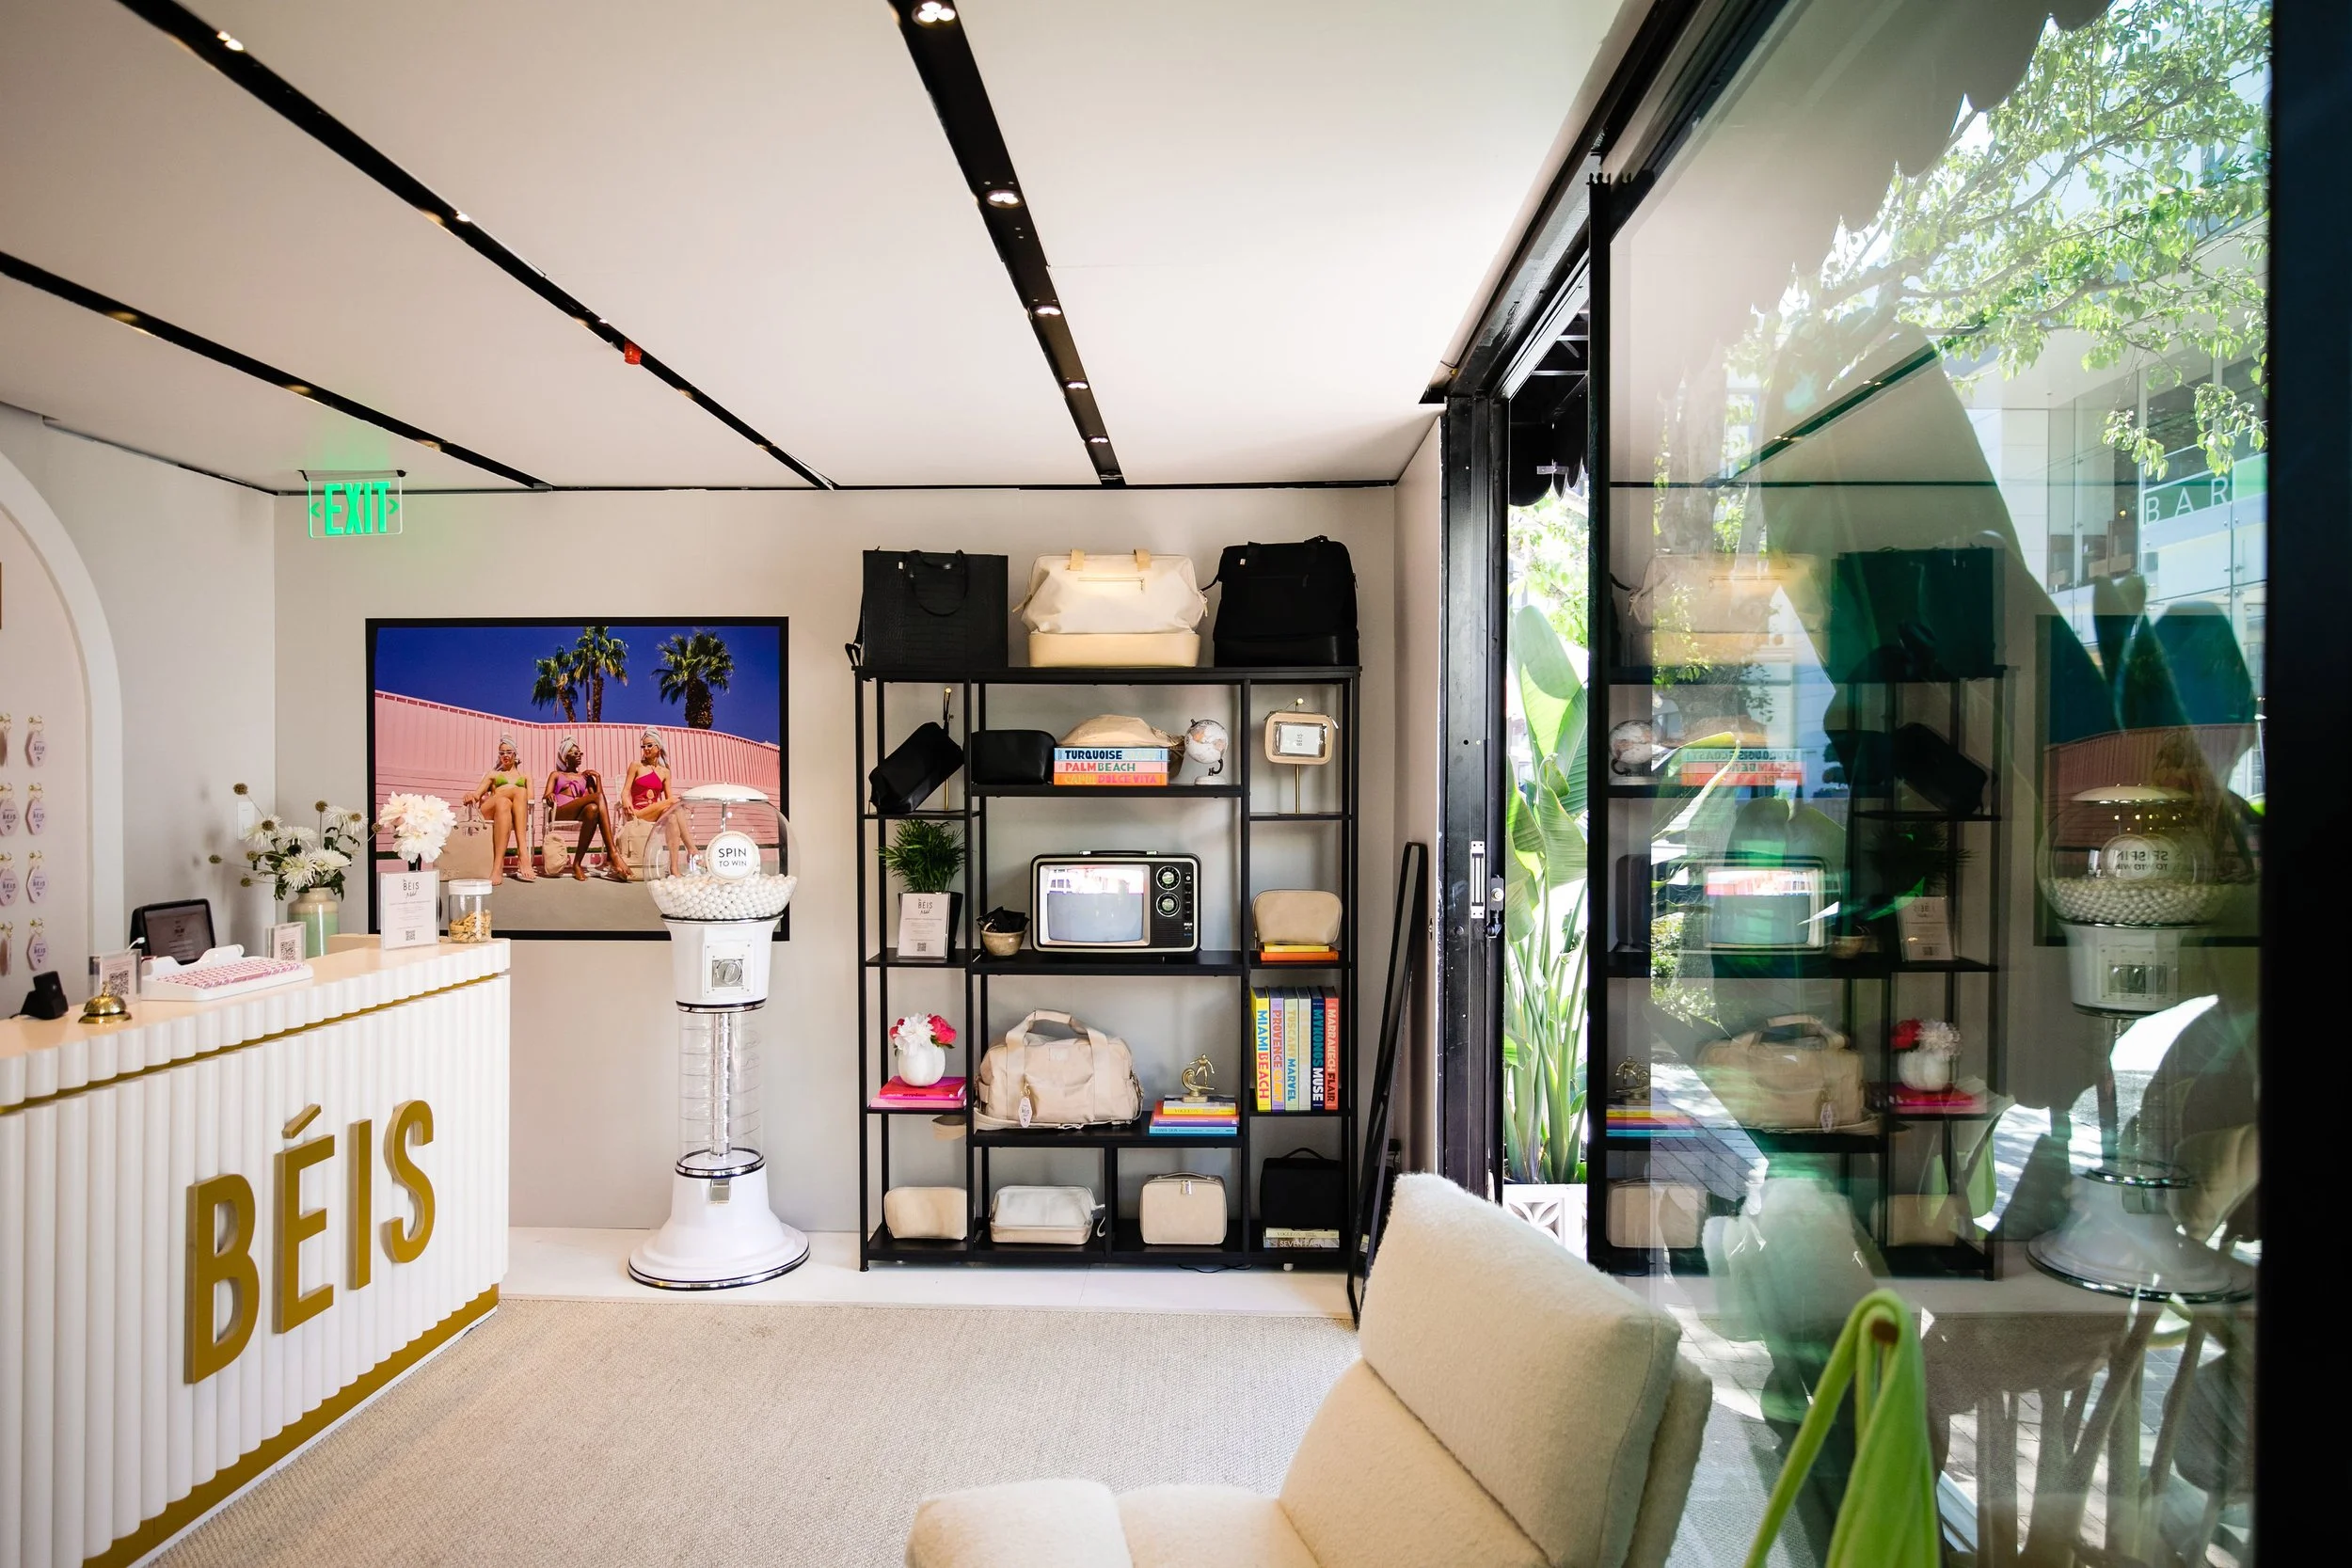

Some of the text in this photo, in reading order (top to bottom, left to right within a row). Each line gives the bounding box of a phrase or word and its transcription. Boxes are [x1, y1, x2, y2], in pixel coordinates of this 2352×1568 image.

[325, 481, 390, 535] EXIT
[2145, 476, 2229, 525] BAR
[1064, 750, 1122, 760] TURQUOISE
[1065, 762, 1136, 771] PALM BEACH
[1098, 774, 1131, 784] DOLCE
[1132, 774, 1157, 784] VITA
[718, 847, 747, 858] SPIN
[1257, 1010, 1270, 1099] MIAMI BEACH
[1272, 1010, 1283, 1069] PROVENCE
[1287, 1010, 1296, 1101] TUSCANY MARVEL
[1312, 1009, 1324, 1101] MYKONOS MUSE
[1327, 1008, 1336, 1102] MARRAKECH FLAIR
[184, 1099, 436, 1385] BÉIS
